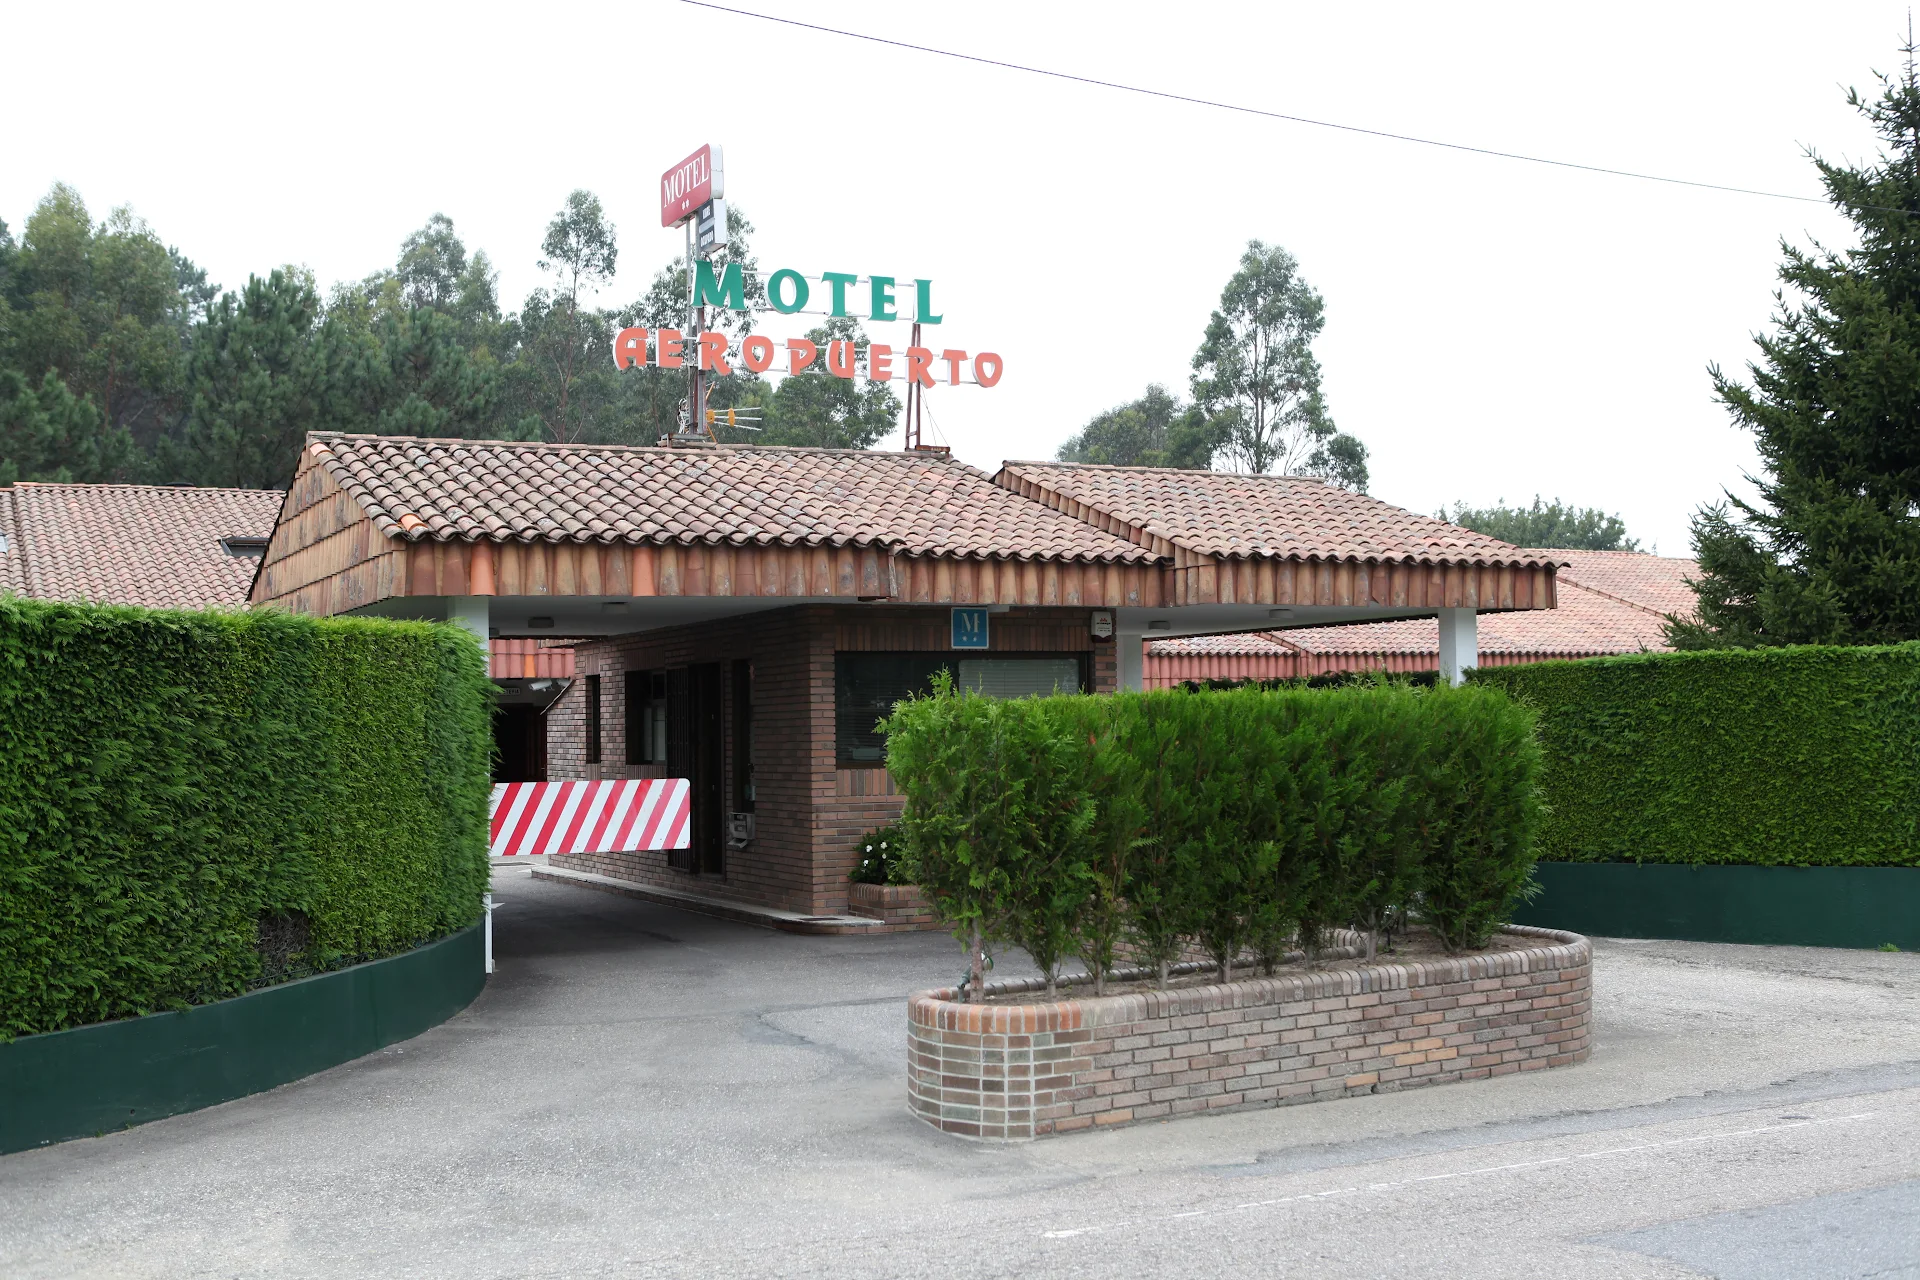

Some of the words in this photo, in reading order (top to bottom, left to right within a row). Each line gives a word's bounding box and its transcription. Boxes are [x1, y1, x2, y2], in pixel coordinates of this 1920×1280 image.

[663, 153, 710, 208] MOTEL
[691, 260, 944, 325] MOTEL
[613, 327, 1004, 388] AEROPUERTO
[961, 612, 979, 633] M
